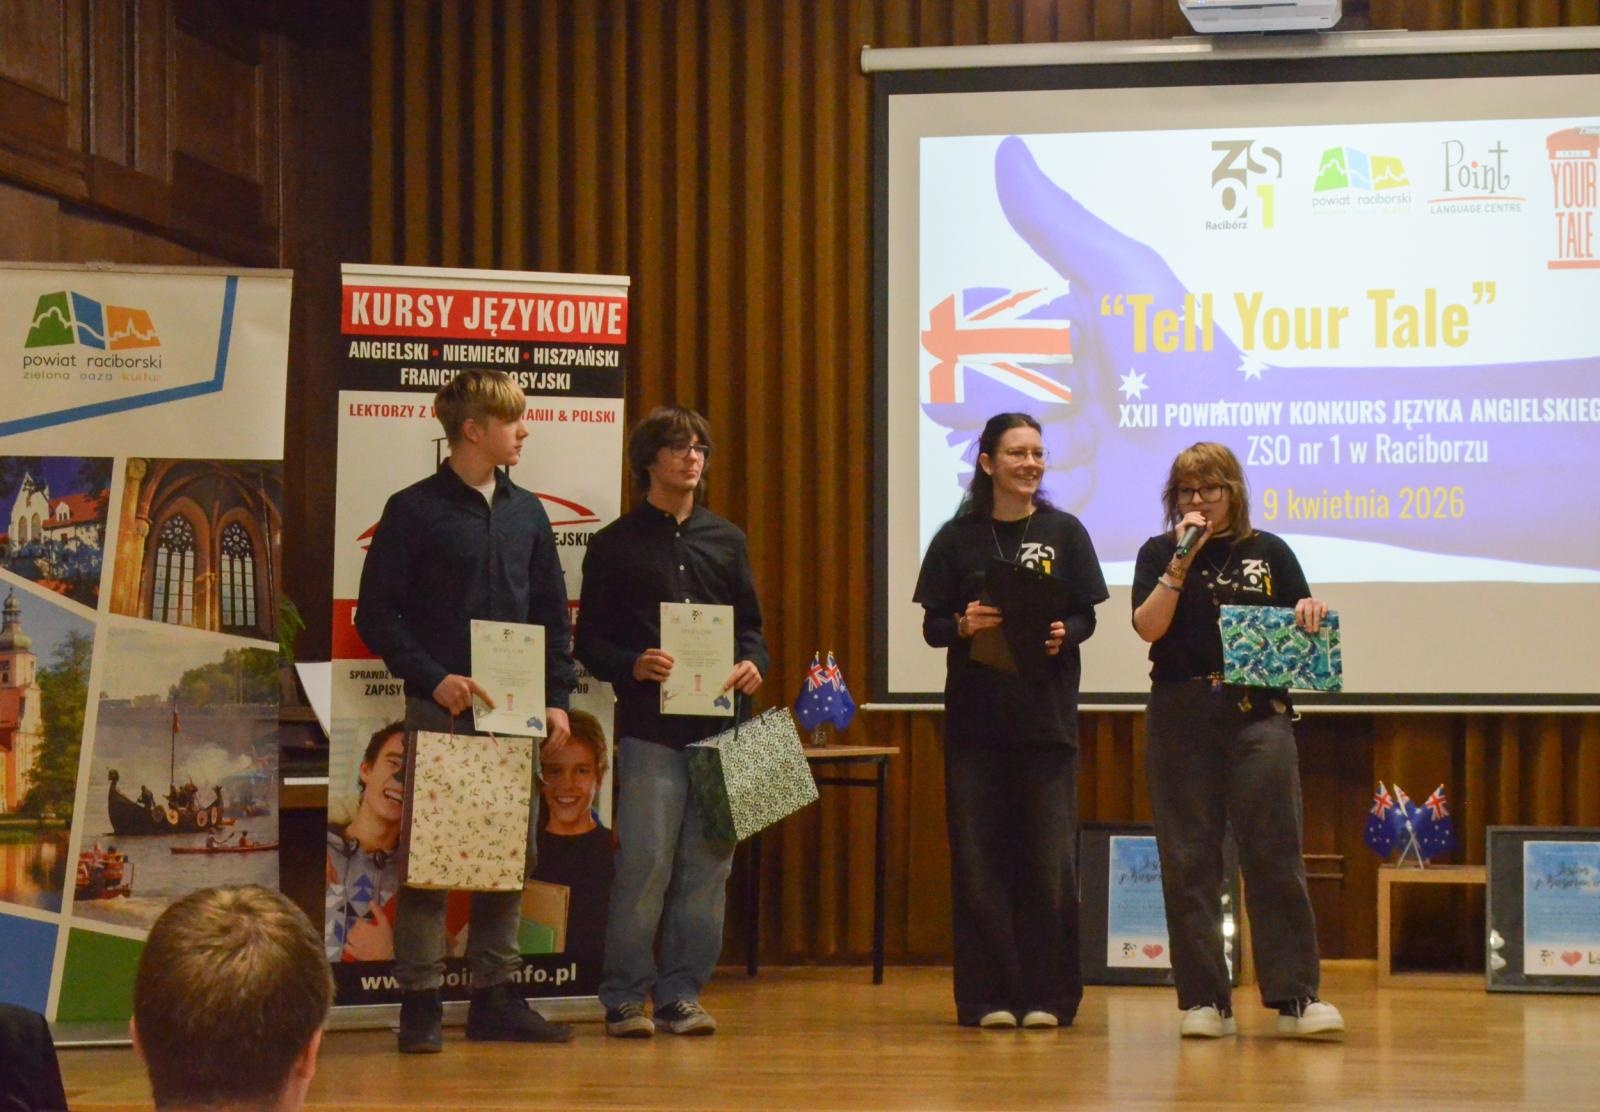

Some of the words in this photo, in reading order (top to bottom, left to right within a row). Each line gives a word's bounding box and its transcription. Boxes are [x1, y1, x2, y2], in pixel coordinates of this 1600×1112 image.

[1442, 139, 1510, 193] Point
[1312, 195, 1350, 208] powiat
[1357, 191, 1412, 205] raciborski
[1550, 161, 1598, 209] YOUR
[1430, 203, 1482, 214] LANGUAGE
[1484, 202, 1522, 213] CENTRE
[1205, 219, 1248, 231] Racibórz
[1555, 212, 1593, 258] TALE
[351, 291, 454, 329] KURSY
[463, 296, 622, 337] JĘZYKOWE
[1233, 291, 1349, 351] Your
[23, 352, 77, 369] powiat
[87, 353, 163, 369] raciborski
[348, 341, 429, 361] ANGIELSKI
[443, 343, 520, 364] NIEMIECKI
[533, 346, 619, 367] HISZPAŃSKI
[23, 369, 70, 380] zielona
[79, 373, 113, 381] oaza
[349, 403, 415, 418] LEKTORZY
[418, 404, 426, 418] Z
[558, 410, 568, 422] &
[572, 410, 616, 423] POLSKI
[1118, 403, 1158, 428] XXII
[1165, 401, 1283, 427] POWIATOWY
[1290, 400, 1387, 425] KONKURS
[1392, 399, 1464, 431] JĘZYKA
[1246, 434, 1291, 466] ZSO
[1299, 442, 1323, 464] nr
[1330, 434, 1341, 464] 1
[1349, 441, 1368, 464] w
[1376, 432, 1489, 464] Raciborzu
[1263, 488, 1279, 521] 9
[1287, 487, 1391, 520] kwietnia
[1398, 486, 1465, 520] 2026
[364, 683, 402, 696] ZAPISY
